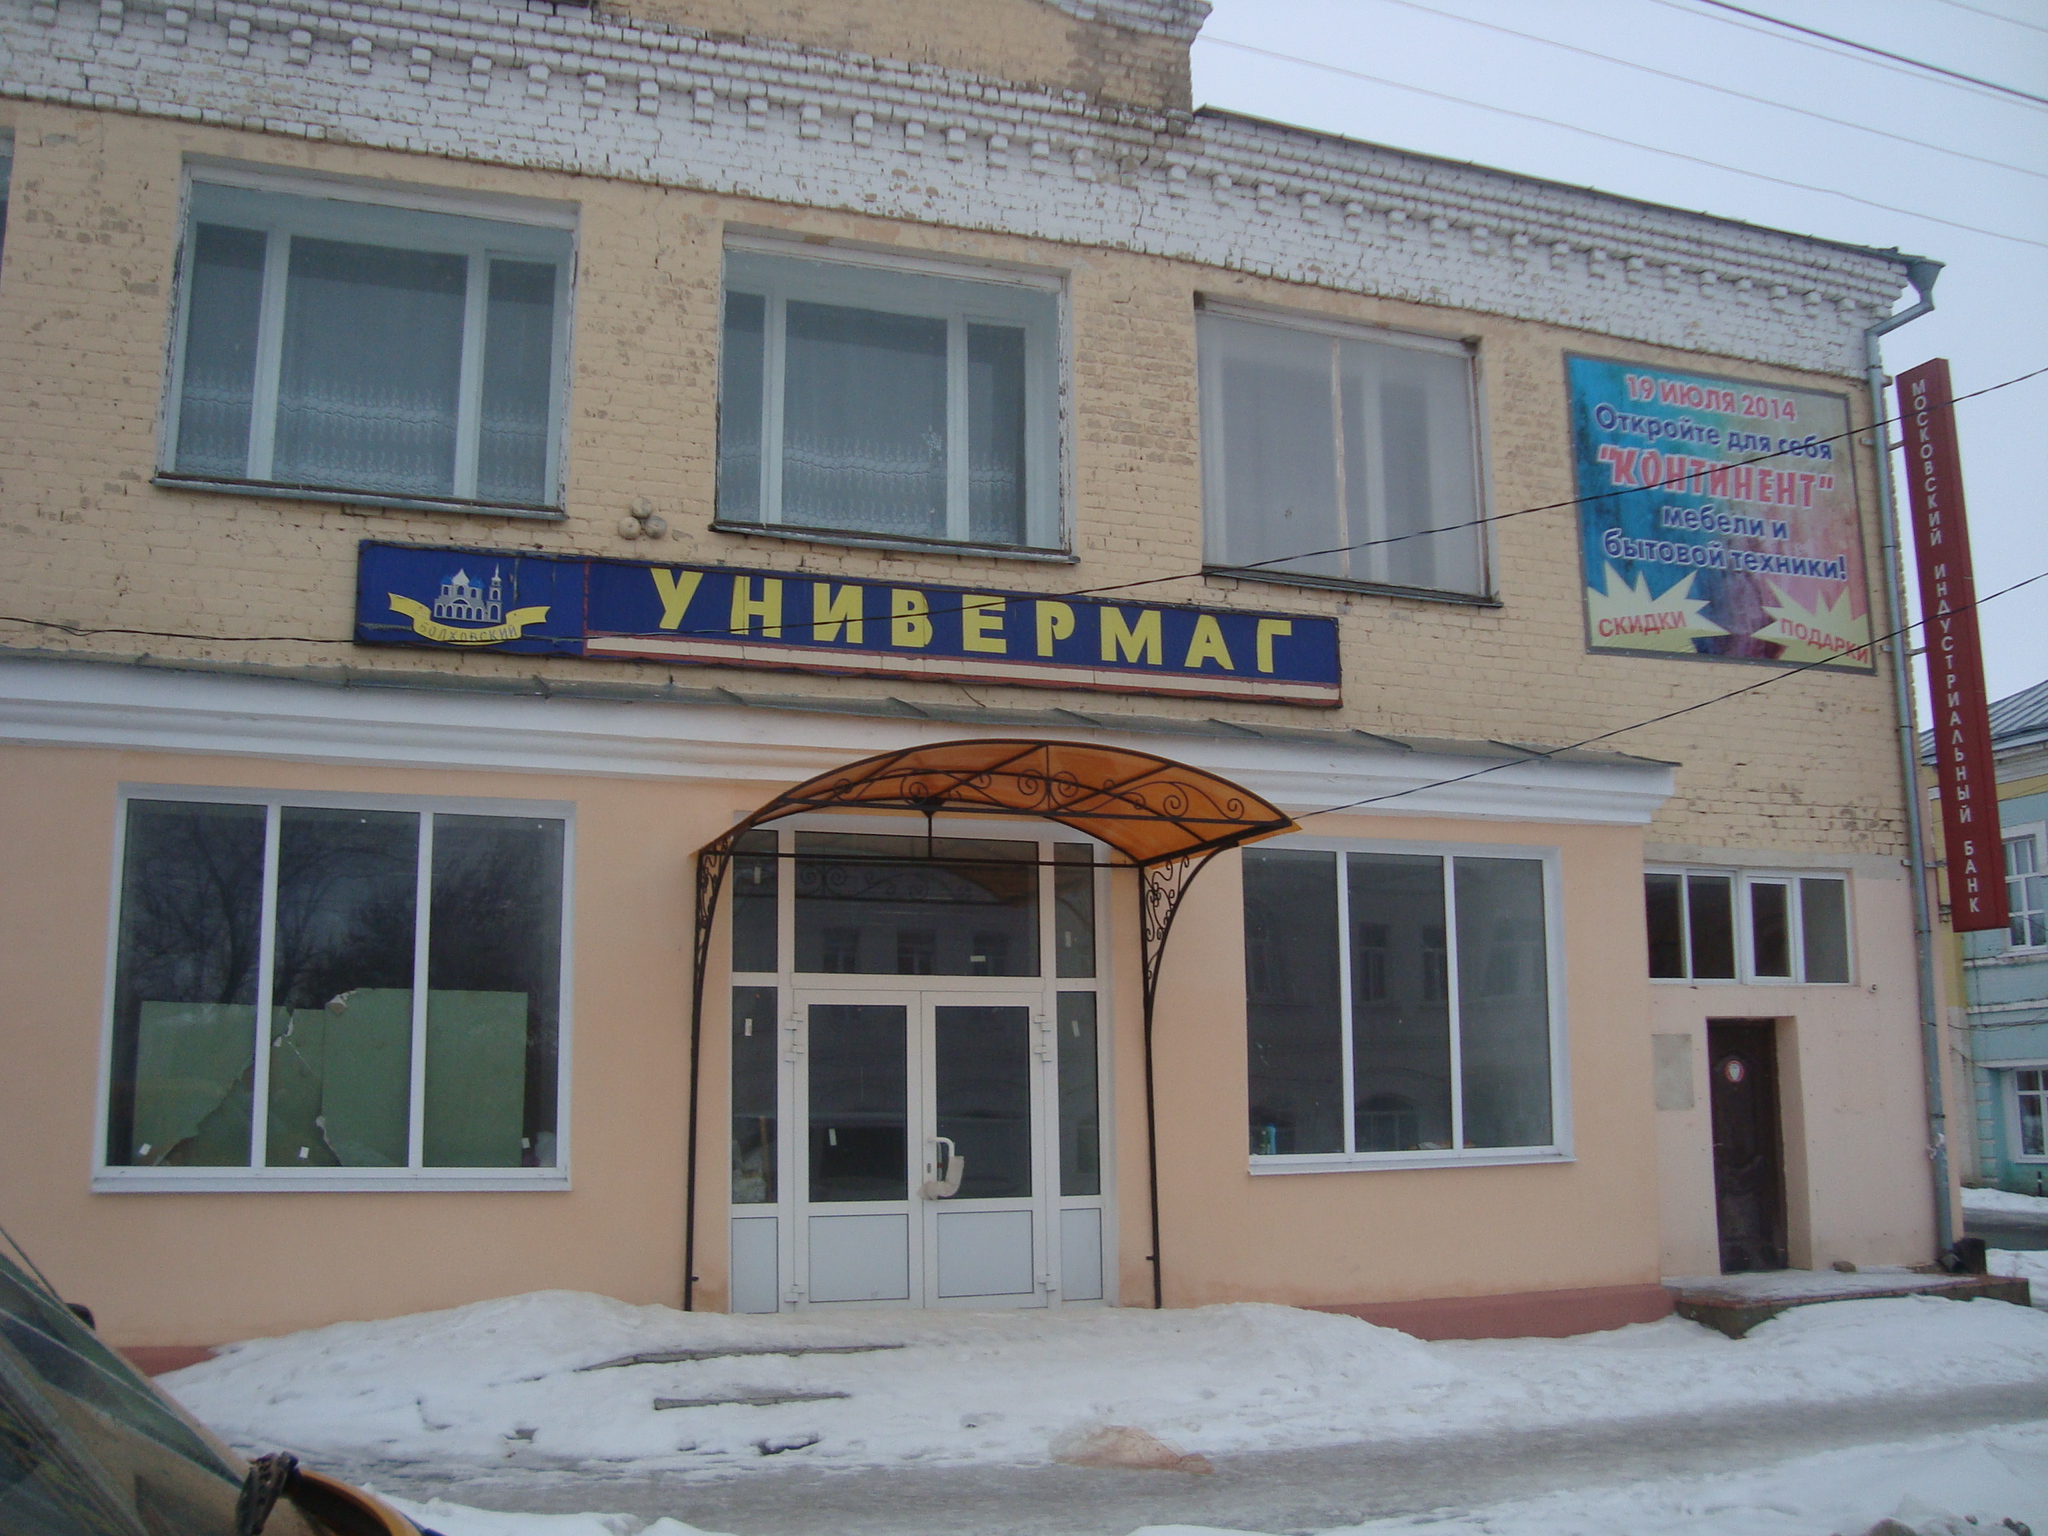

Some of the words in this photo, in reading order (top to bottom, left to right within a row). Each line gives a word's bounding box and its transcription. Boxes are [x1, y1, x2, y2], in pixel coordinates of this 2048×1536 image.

[1626, 375, 1655, 401] 19
[1661, 379, 1736, 414] ИЮЛЯ
[1741, 395, 1796, 422] 2014
[1594, 402, 1721, 445] Откройте
[1727, 431, 1771, 453] для
[1778, 435, 1833, 461] себя
[1598, 445, 1835, 508] "КОНТИНЕНТ"
[1662, 503, 1765, 538] мебели
[1772, 519, 1788, 540] и
[1603, 528, 1726, 568] бытовой
[1732, 550, 1848, 581] техники!
[648, 567, 1293, 674] УНИВЕРМАГ
[1598, 610, 1688, 638] СКИДКИ
[1780, 618, 1870, 665] ПОДАРКИ
[1911, 379, 1943, 548] МОСКОВСКИЙ
[1934, 563, 1972, 823] ИНДУСТРИАЛЬНЫЙ
[1964, 840, 1980, 913] БАНК
